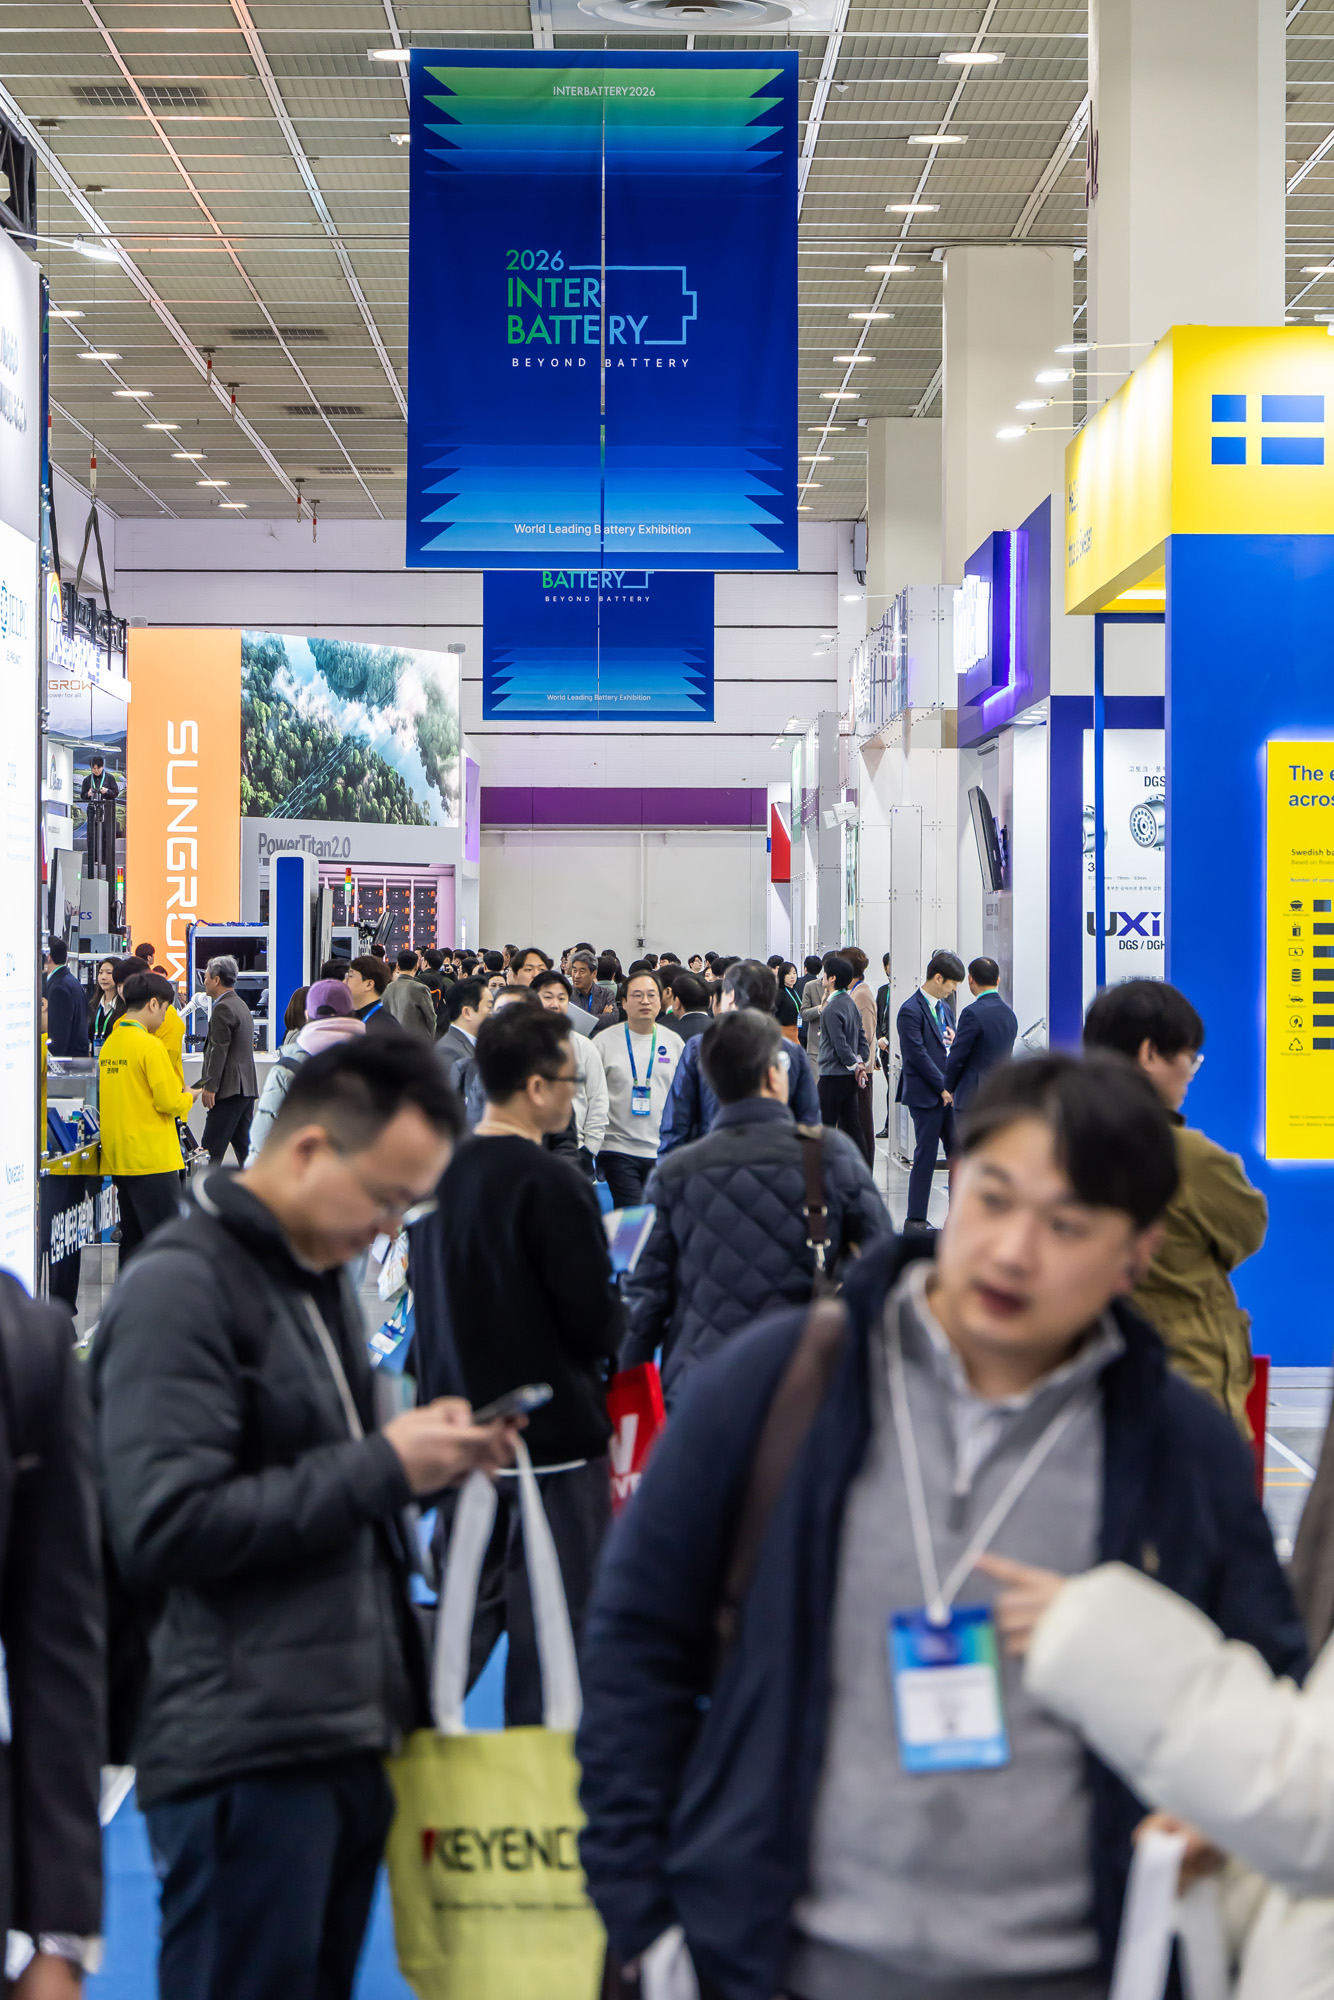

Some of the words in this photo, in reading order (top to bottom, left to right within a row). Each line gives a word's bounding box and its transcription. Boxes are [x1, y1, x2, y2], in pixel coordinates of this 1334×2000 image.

[553, 86, 656, 97] INTERBATTERY2026
[506, 249, 565, 271] 2026
[507, 277, 602, 308] INTER
[507, 314, 649, 345] BATTERY
[512, 358, 586, 367] BEYOND
[604, 358, 689, 368] BATTERY
[514, 524, 546, 534] World
[548, 524, 592, 536] Leading
[594, 524, 636, 537] Battery
[638, 525, 692, 535] Exhibition
[542, 571, 626, 589] BATTERY
[567, 694, 593, 702] Leading
[594, 694, 618, 702] Battery
[1289, 765, 1324, 781] The
[1144, 776, 1165, 787] DGS
[258, 832, 351, 858] PowerTitan2.0
[166, 720, 198, 988] SUNGROW
[1119, 940, 1139, 950] DGS
